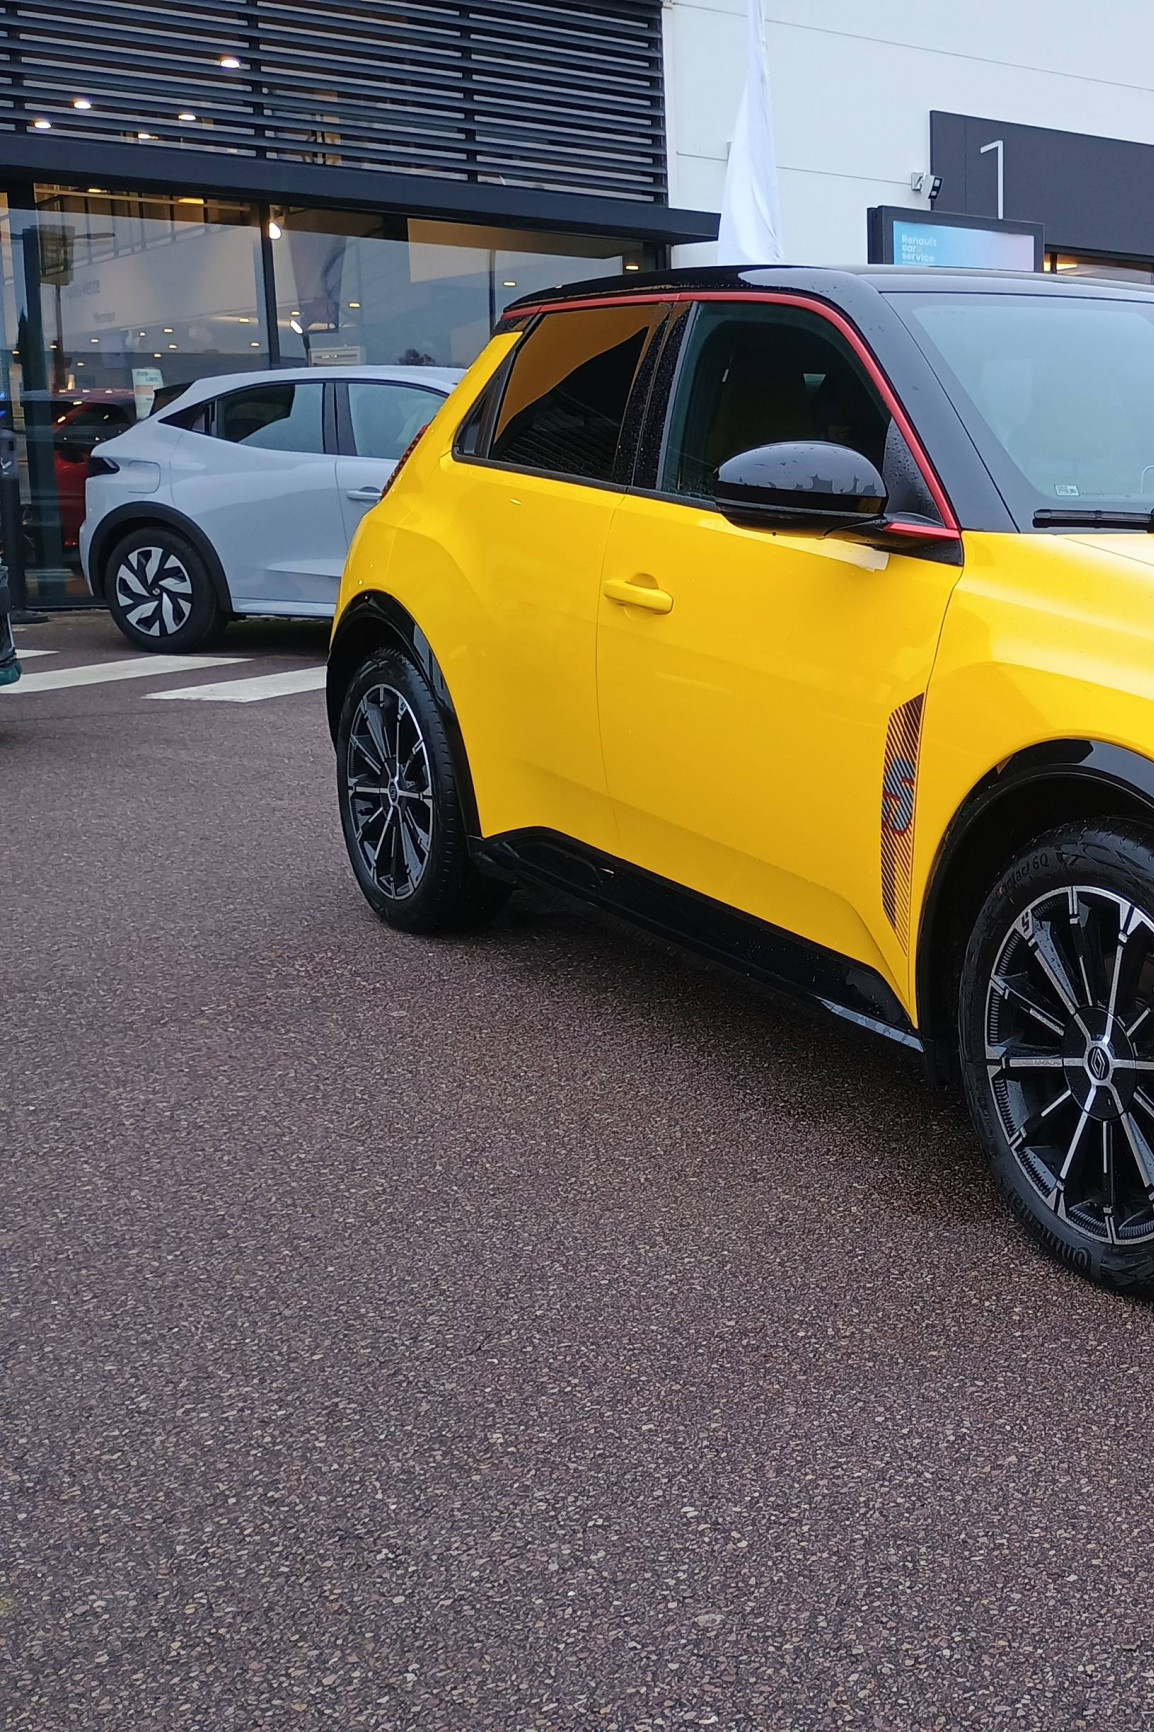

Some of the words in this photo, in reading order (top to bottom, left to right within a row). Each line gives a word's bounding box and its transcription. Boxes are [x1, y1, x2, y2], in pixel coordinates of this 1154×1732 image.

[979, 139, 1004, 220] 1
[901, 234, 937, 247] Renault
[901, 252, 935, 262] service
